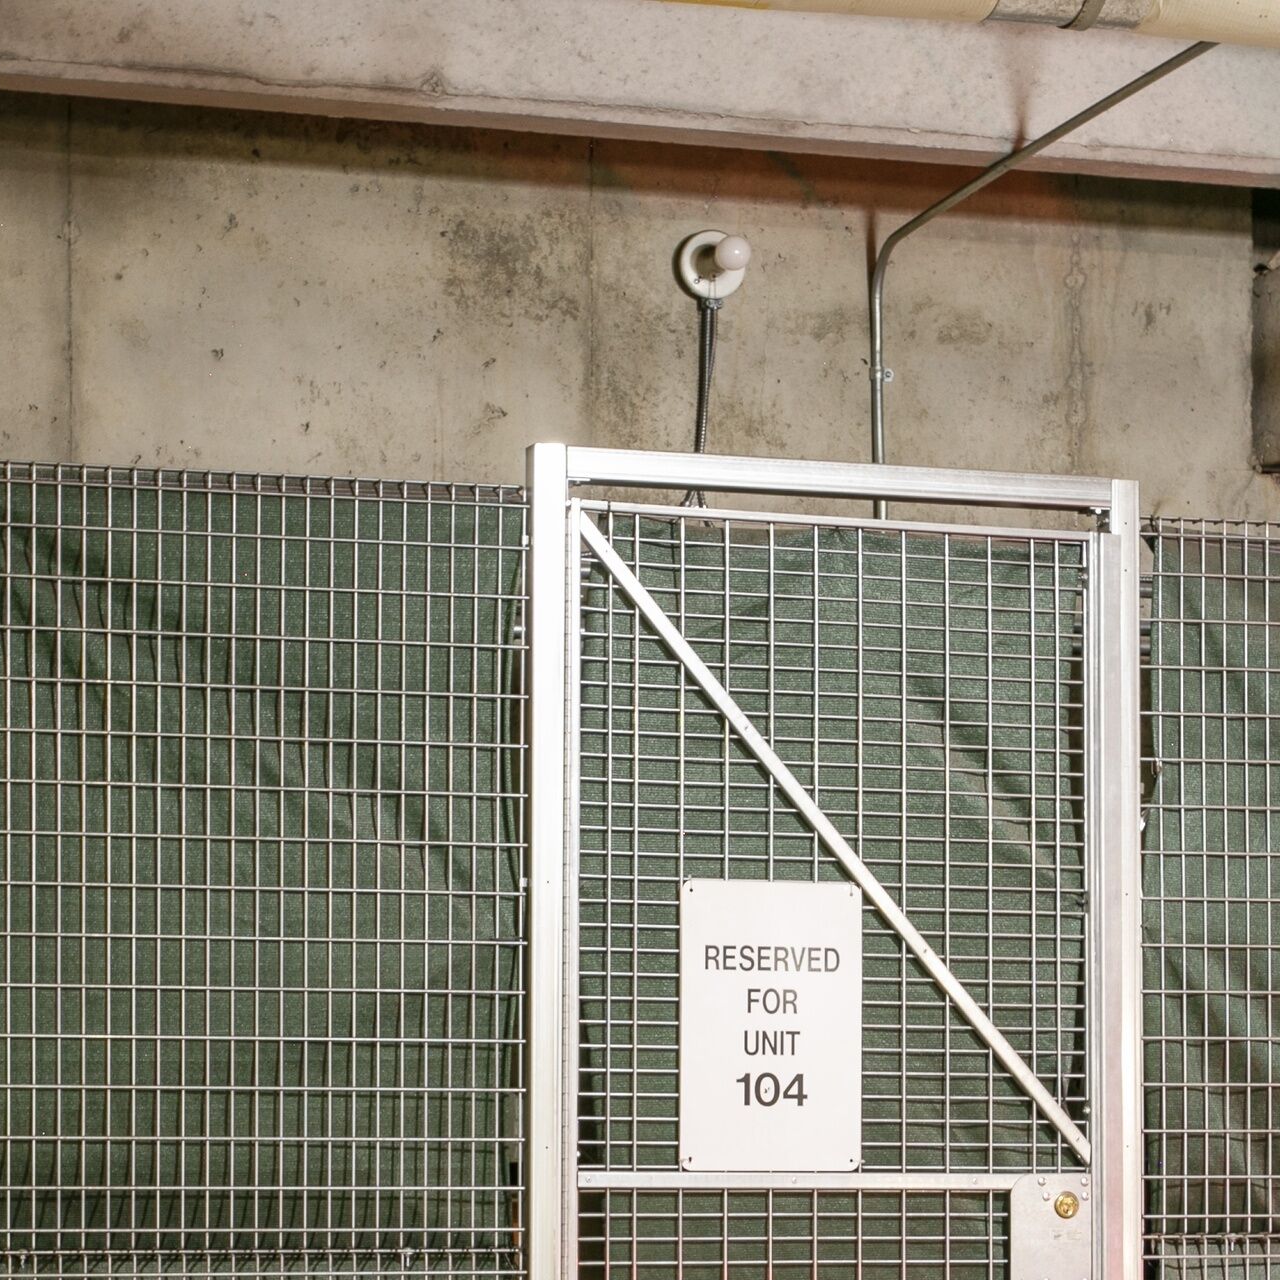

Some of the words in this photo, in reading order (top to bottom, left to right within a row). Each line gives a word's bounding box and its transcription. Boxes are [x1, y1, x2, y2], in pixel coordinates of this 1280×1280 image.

[704, 944, 841, 973] RESERVED
[746, 987, 798, 1015] FOR
[743, 1029, 801, 1057] UNIT
[735, 1071, 809, 1108] 104
